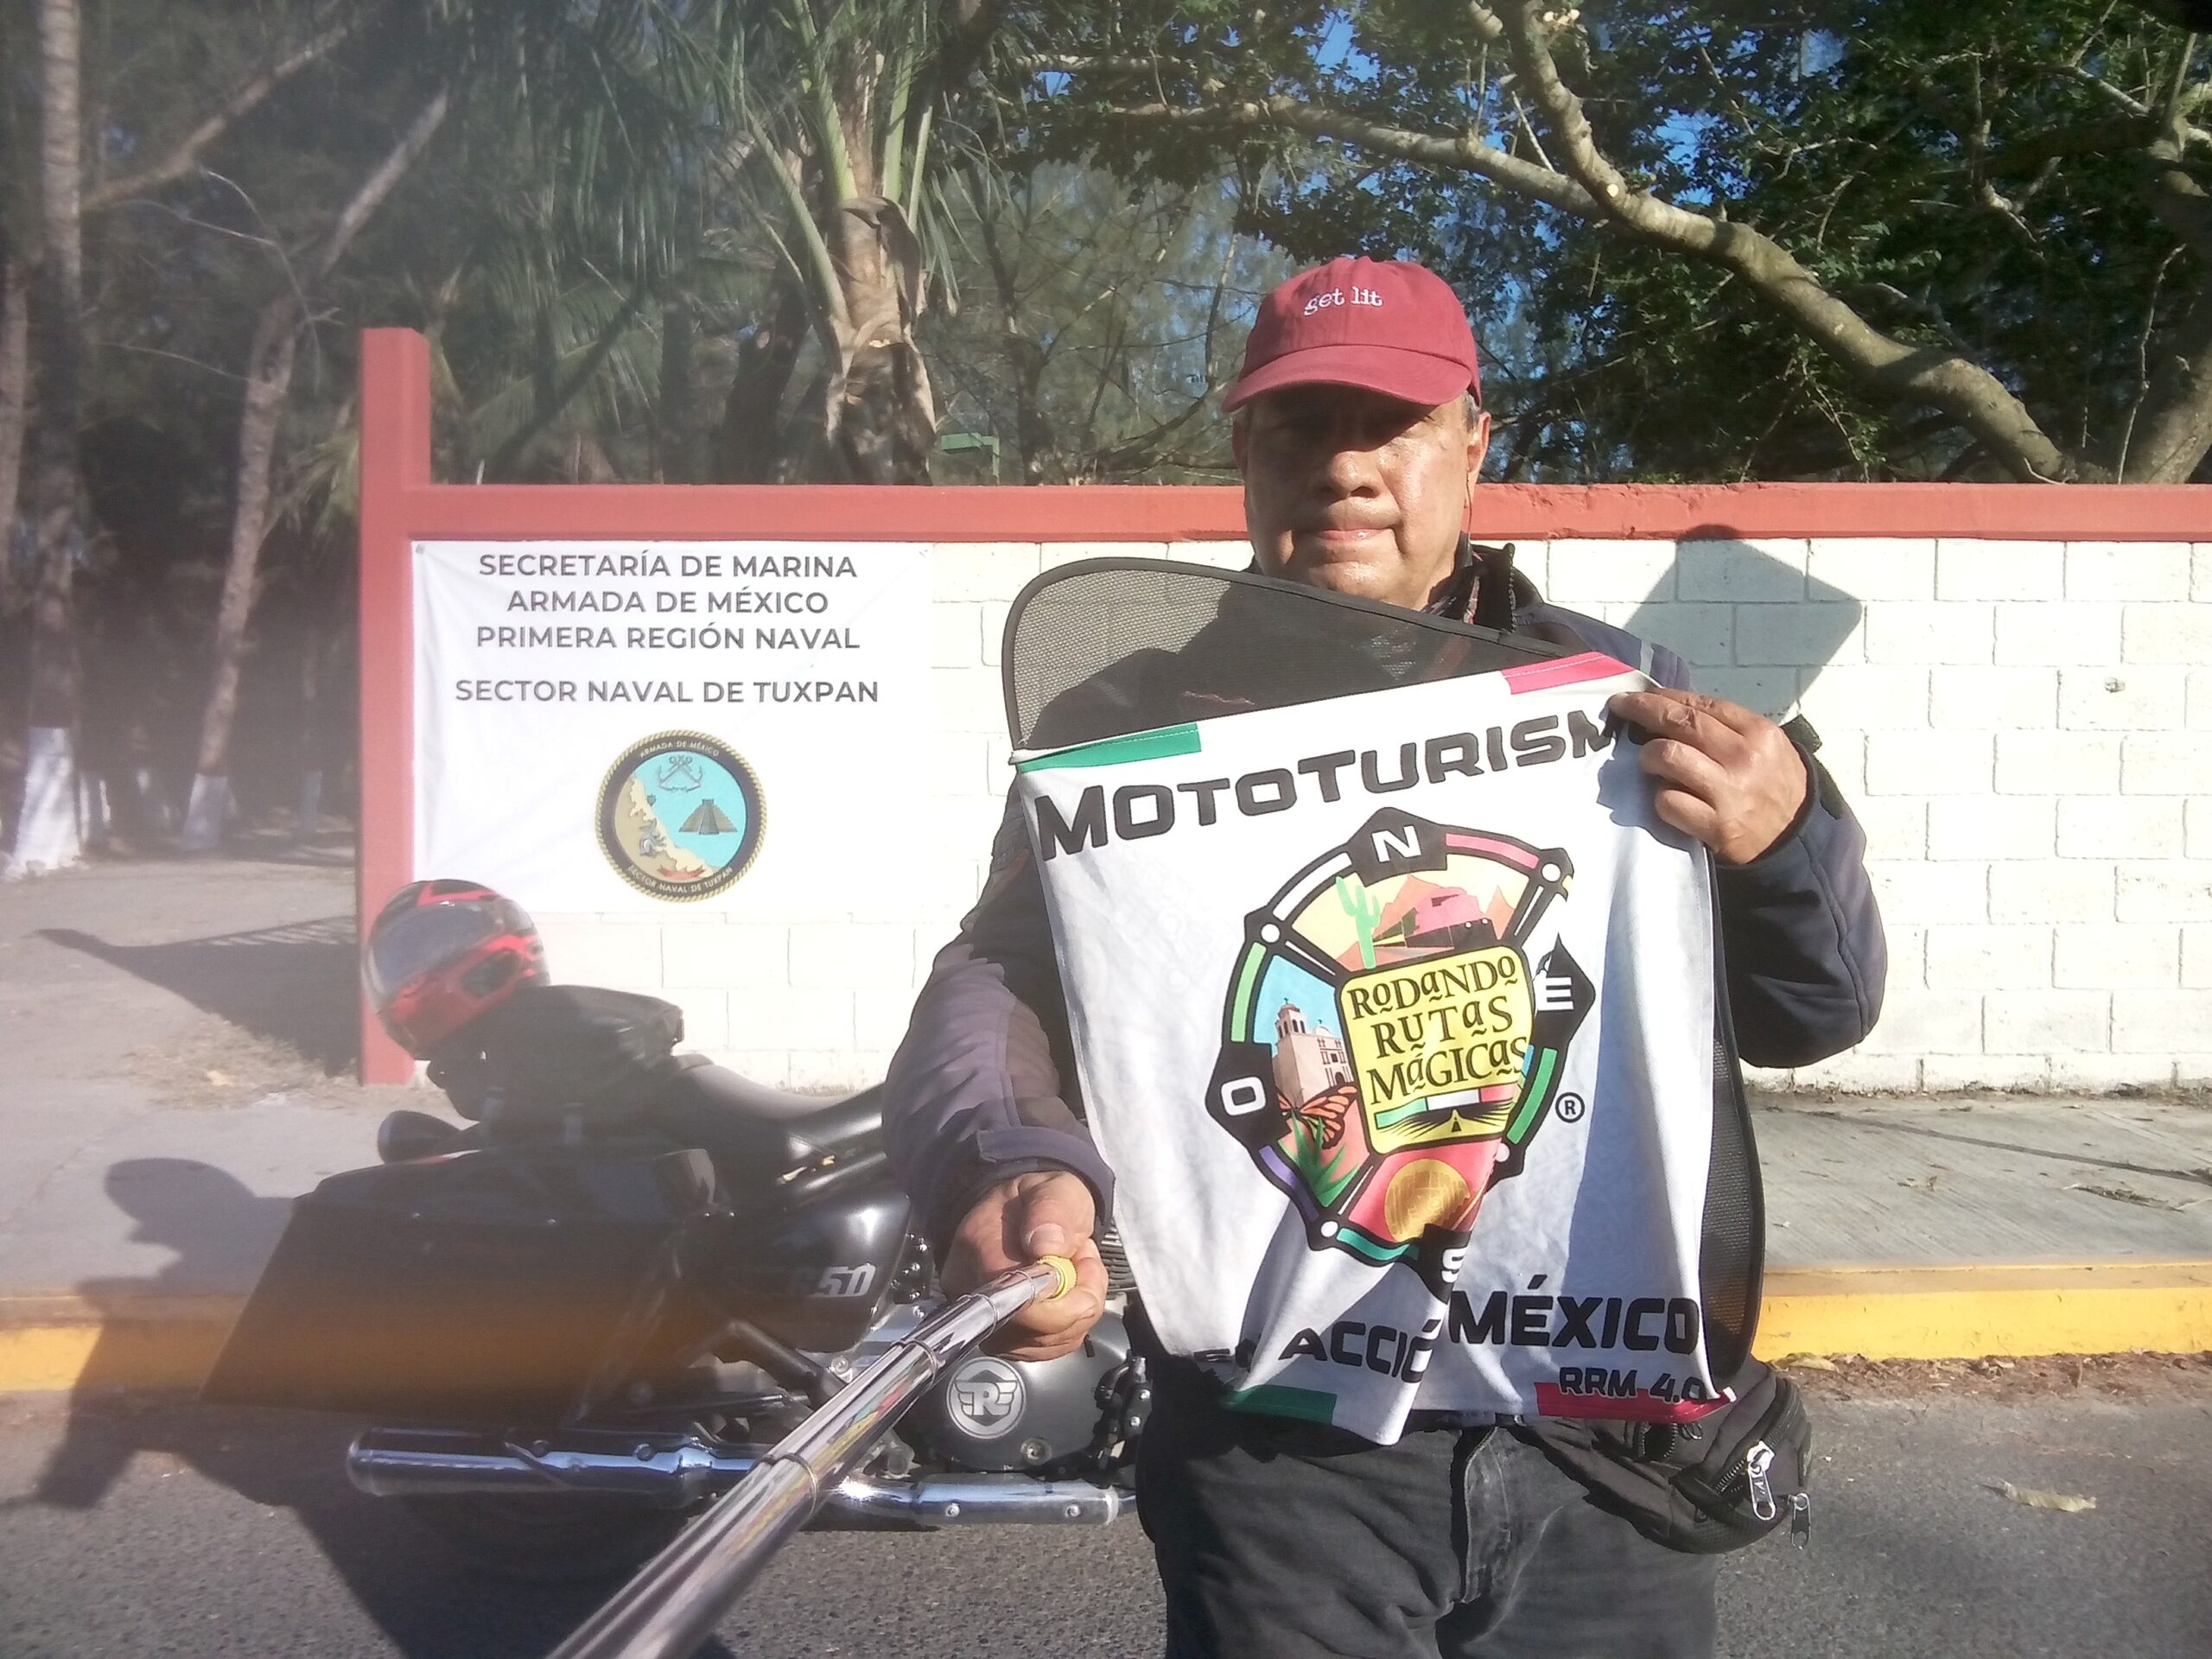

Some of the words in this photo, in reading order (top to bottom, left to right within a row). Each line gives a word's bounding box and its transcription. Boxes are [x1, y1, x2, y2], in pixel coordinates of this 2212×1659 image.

[1303, 288, 1345, 316] get
[1350, 285, 1383, 307] lit
[479, 550, 671, 577] SECRETARÍA
[680, 556, 723, 577] DE
[732, 556, 858, 578] MARINA
[506, 590, 648, 613] ARMADA
[656, 591, 697, 613] DE
[708, 586, 830, 613] MÉXICO
[477, 626, 617, 649] PRIMERA
[626, 621, 745, 649] REGIÓN
[756, 627, 861, 650] NAVAL
[454, 679, 578, 702] SECTOR
[588, 680, 694, 702] NAVAL
[703, 681, 745, 702] DE
[753, 681, 879, 703] TUXPAN
[639, 741, 673, 759] ARMADA
[690, 741, 721, 757] MÉXICO
[1034, 709, 1642, 861] MOTOTURISM
[1371, 825, 1422, 862] N
[627, 864, 658, 888] SECTOR
[658, 881, 689, 893] NAVAL
[690, 884, 702, 893] DE
[704, 866, 734, 889] TUXPAN
[1221, 1076, 1267, 1116] O
[1277, 1319, 1442, 1384] ACCIÓ
[1447, 1274, 1700, 1356] MÉXICO
[1558, 1366, 1638, 1397] RRM
